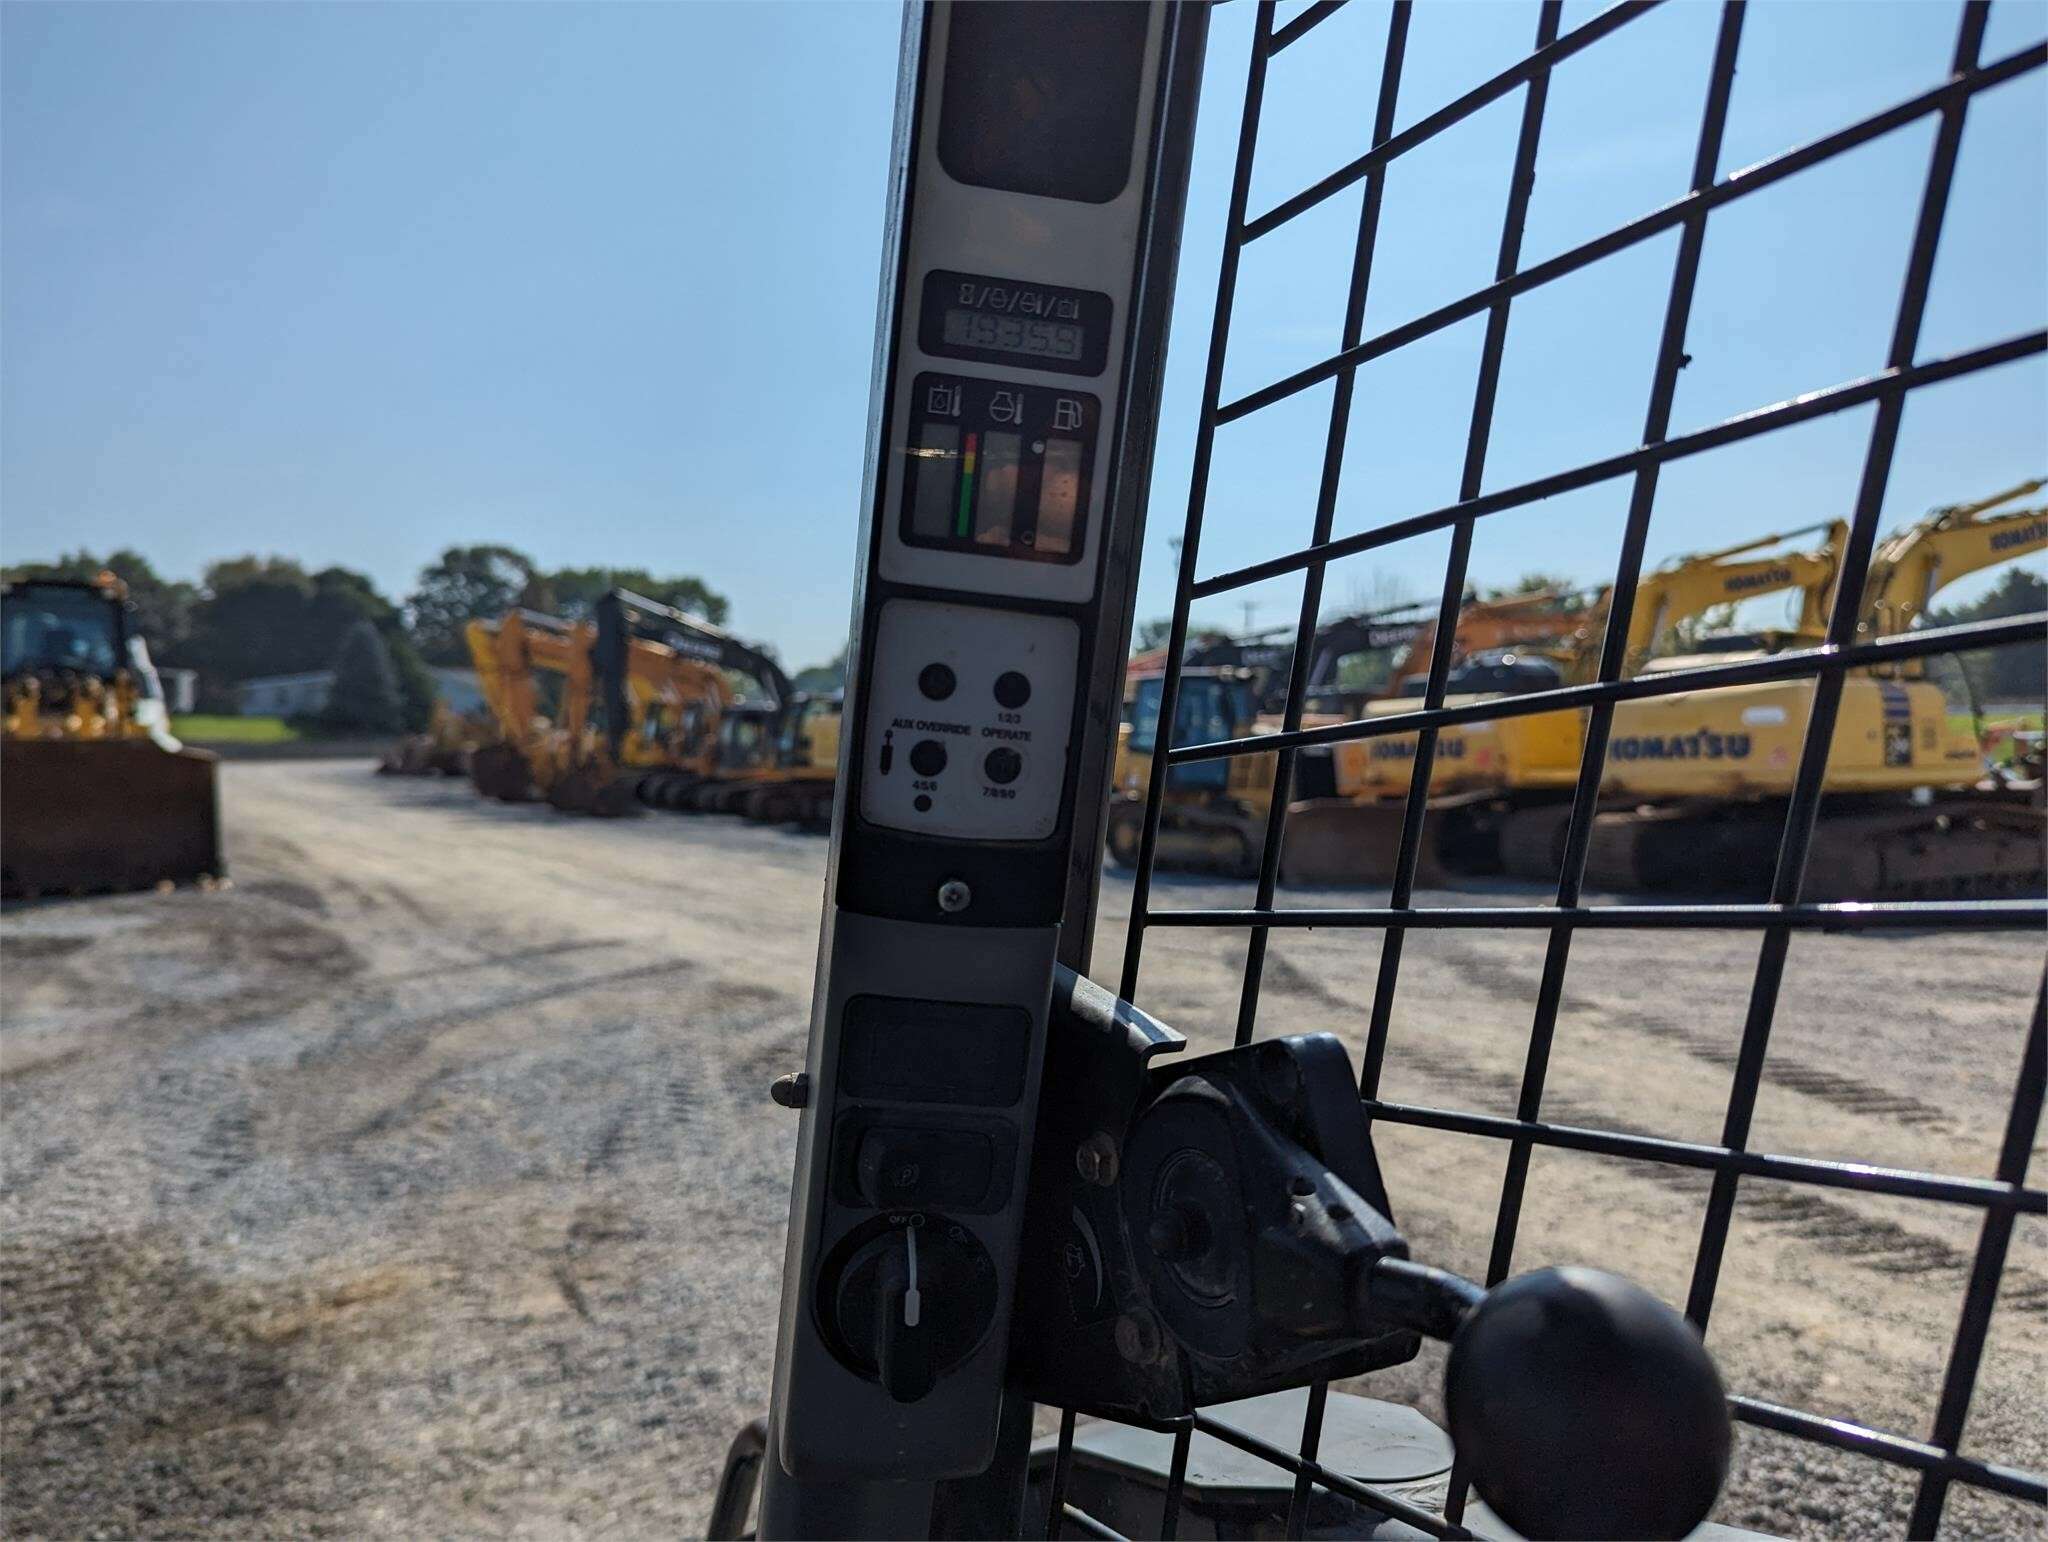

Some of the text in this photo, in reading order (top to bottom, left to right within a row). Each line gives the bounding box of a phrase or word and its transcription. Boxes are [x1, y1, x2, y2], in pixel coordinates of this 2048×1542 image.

[892, 718, 971, 735] AUX OVERRIDE
[982, 727, 1032, 741] OPERATE
